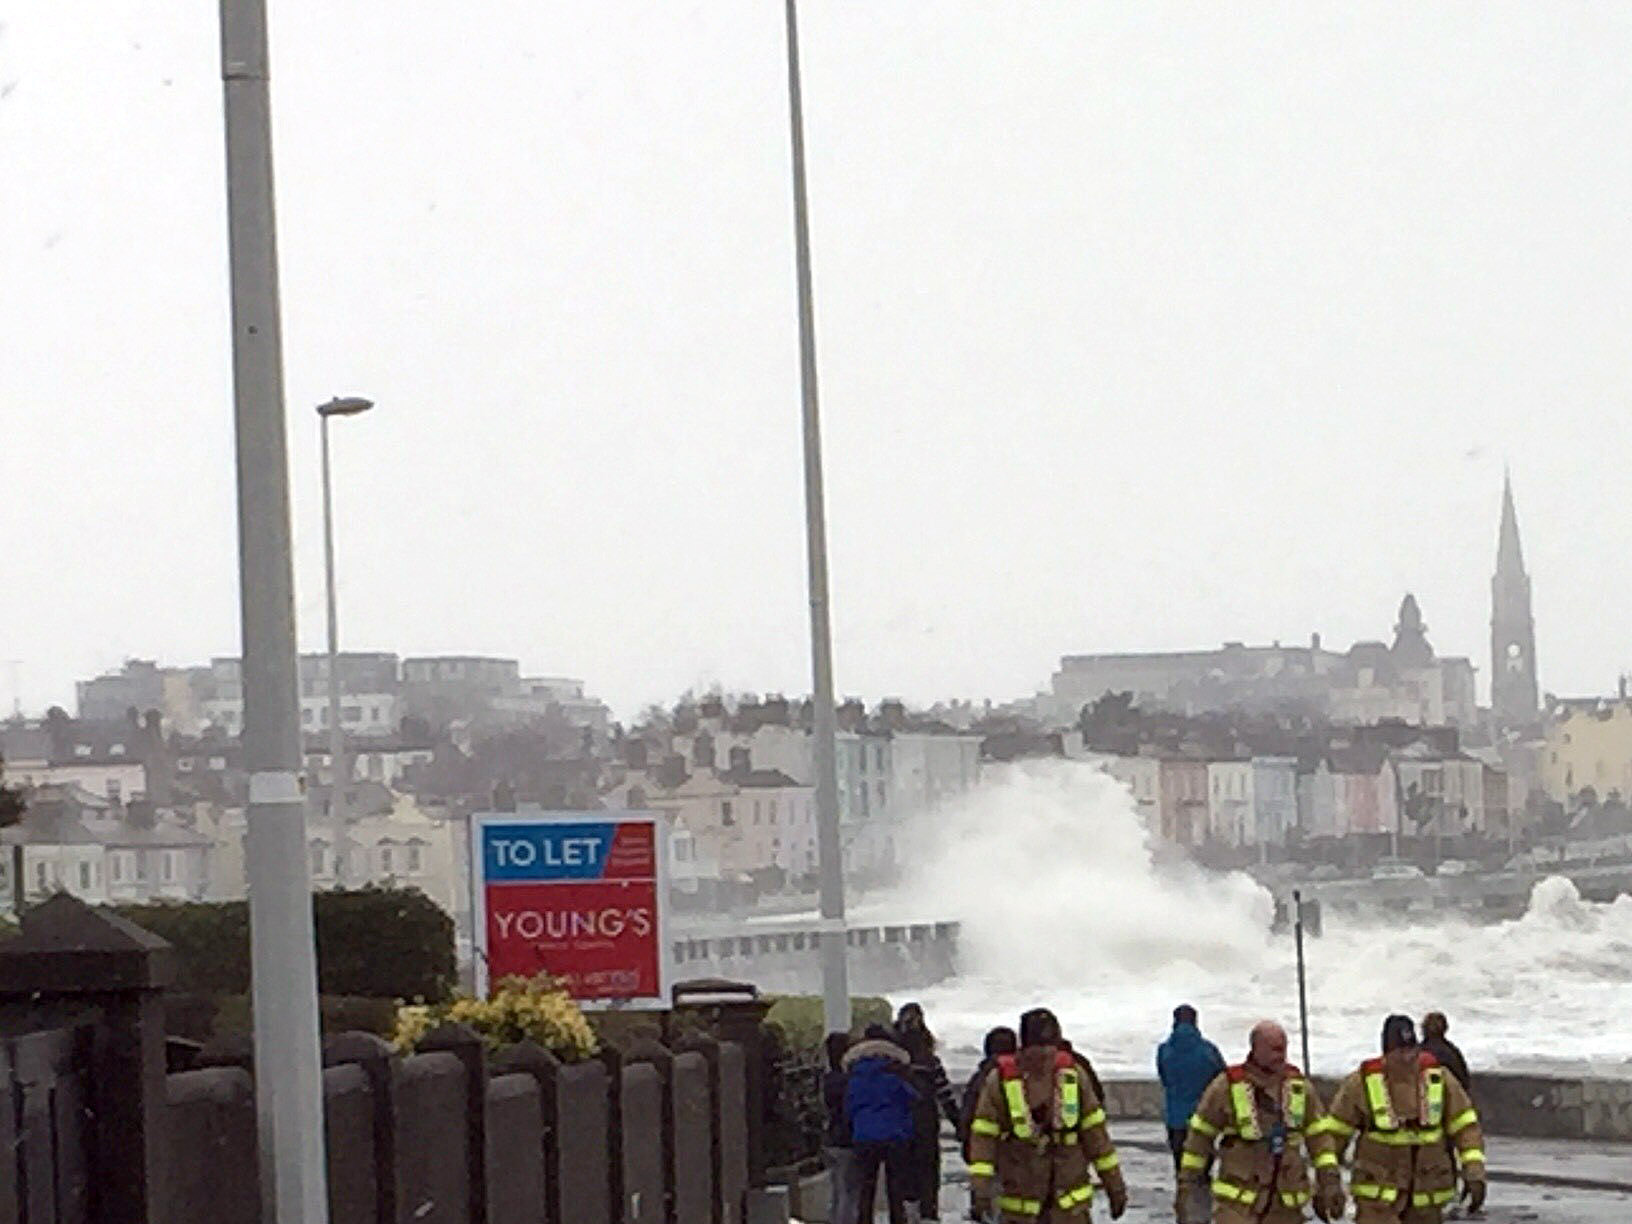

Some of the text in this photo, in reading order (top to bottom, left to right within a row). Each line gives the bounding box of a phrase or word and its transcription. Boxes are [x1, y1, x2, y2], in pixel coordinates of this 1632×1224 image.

[491, 839, 537, 867] TO
[543, 837, 602, 866] LET
[494, 908, 651, 938] YOUNG'S
